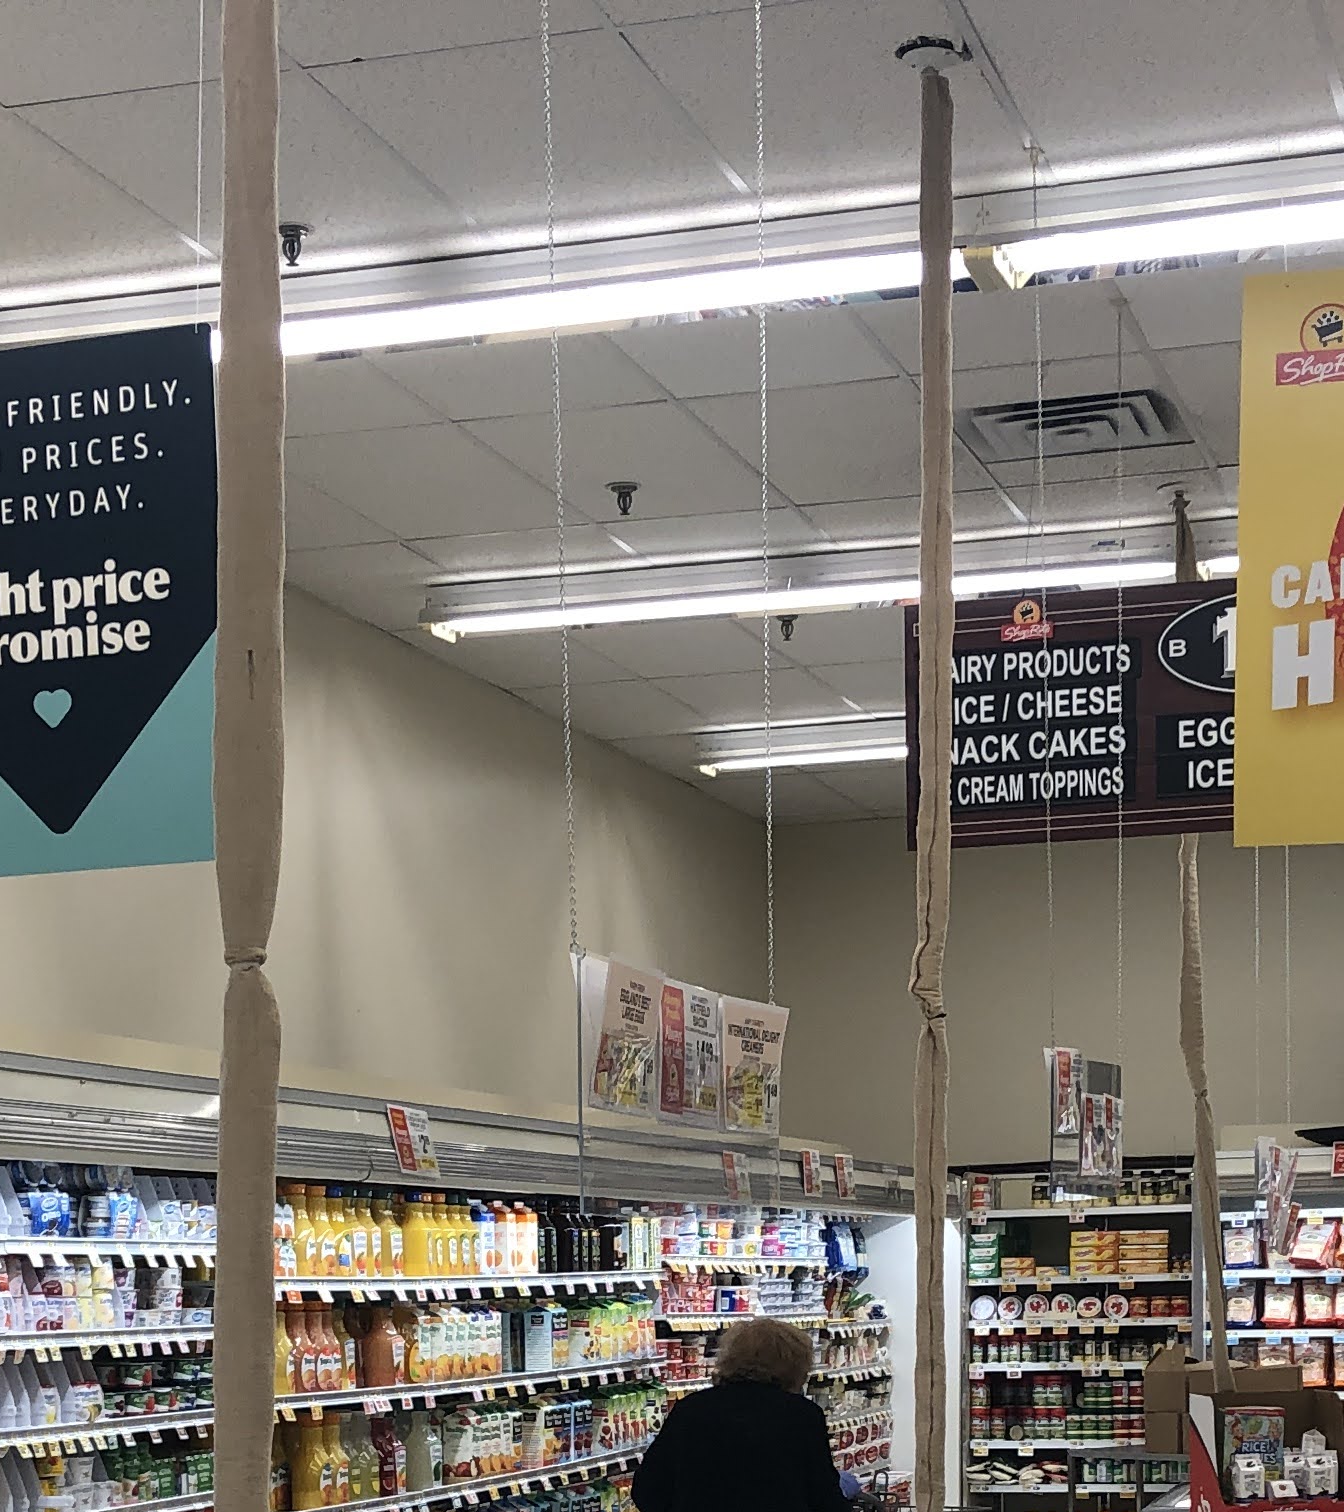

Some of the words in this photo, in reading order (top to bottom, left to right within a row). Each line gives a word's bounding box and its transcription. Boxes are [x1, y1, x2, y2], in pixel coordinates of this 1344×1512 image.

[7, 379, 192, 427] FRIENDLY.
[22, 432, 164, 473] PRICES.
[53, 559, 170, 624] price
[1168, 638, 1187, 658] B
[1213, 606, 1236, 680] 1
[951, 653, 997, 685] AIRY
[1003, 644, 1131, 681] PRODUCTS
[954, 694, 996, 726] ICE
[1017, 685, 1123, 720] CHEESE
[1028, 725, 1126, 759] CAKES
[1178, 716, 1235, 749] EGG
[957, 773, 1023, 806] CREAM
[1029, 766, 1124, 802] TOPPINGS
[1188, 759, 1235, 790] ICE
[1242, 1441, 1267, 1453] RICE
